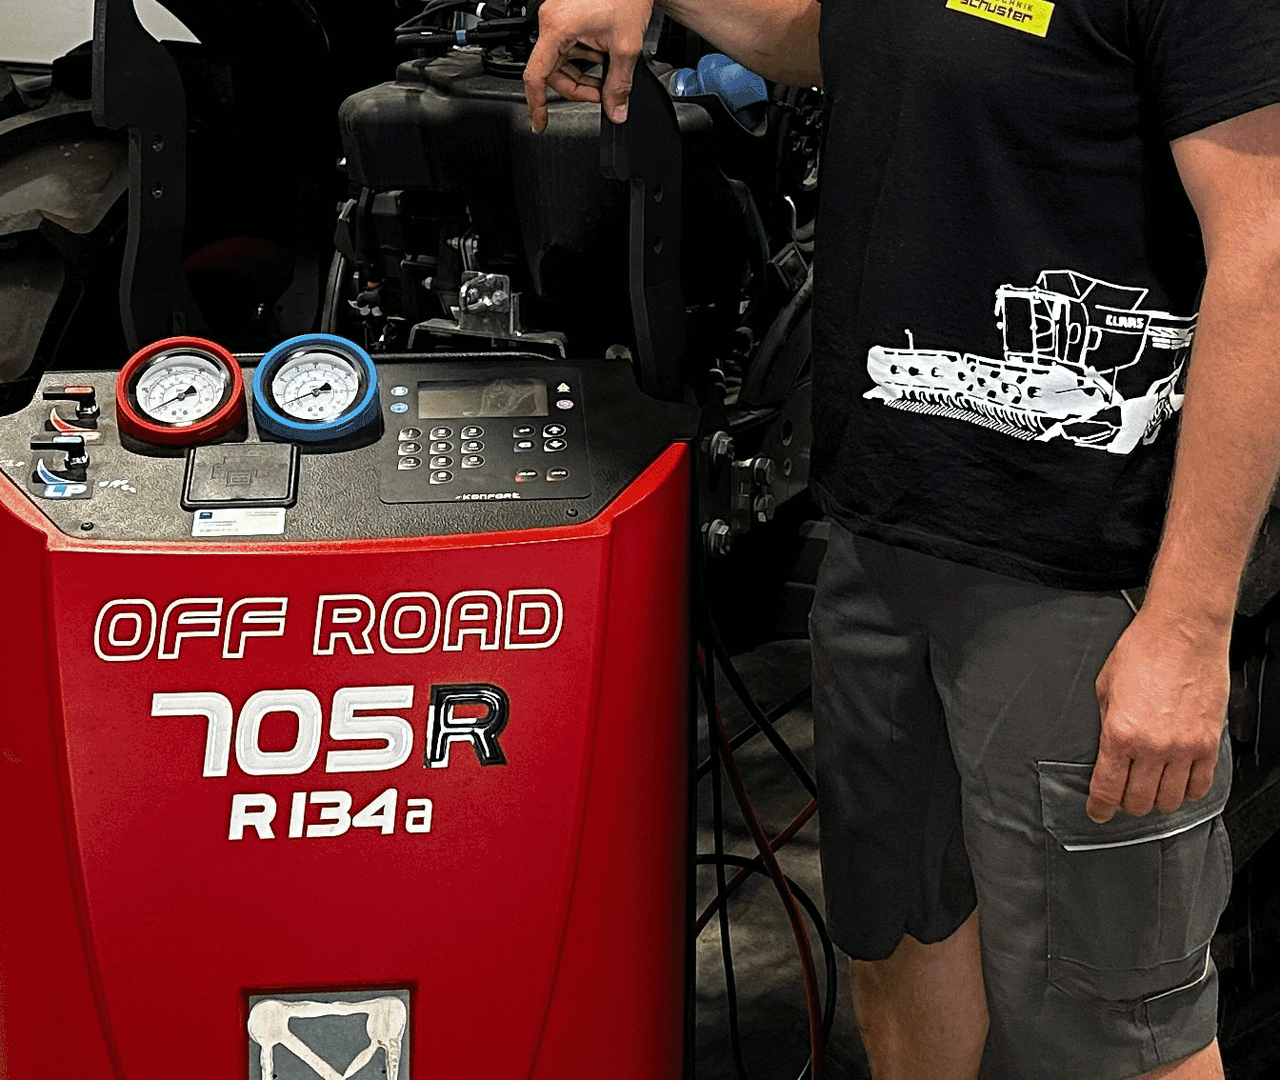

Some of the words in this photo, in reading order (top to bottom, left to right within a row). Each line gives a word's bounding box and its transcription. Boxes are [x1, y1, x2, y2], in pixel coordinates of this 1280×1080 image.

[94, 596, 288, 662] OFF
[313, 588, 564, 656] ROAD
[150, 683, 509, 778] 705R
